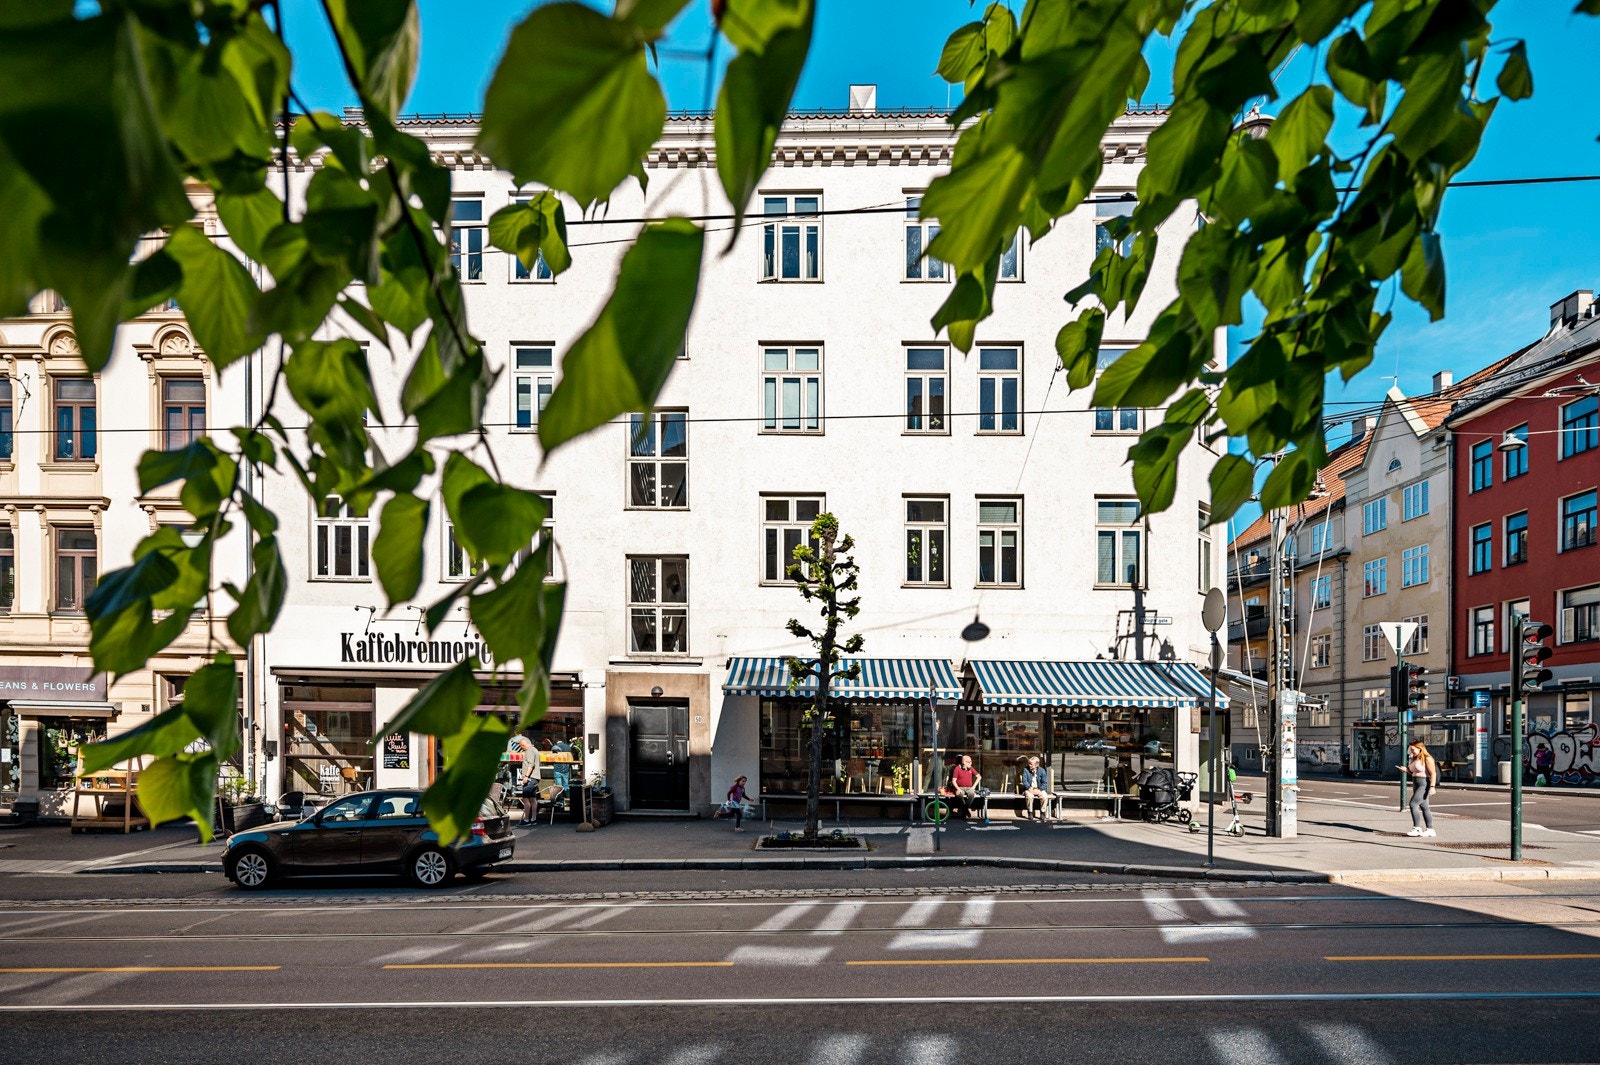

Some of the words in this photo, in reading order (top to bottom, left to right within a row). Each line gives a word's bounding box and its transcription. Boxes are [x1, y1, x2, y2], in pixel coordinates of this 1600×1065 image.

[31, 682, 39, 690] &
[43, 682, 96, 691] FLOWERS
[319, 764, 340, 775] Kaffe
